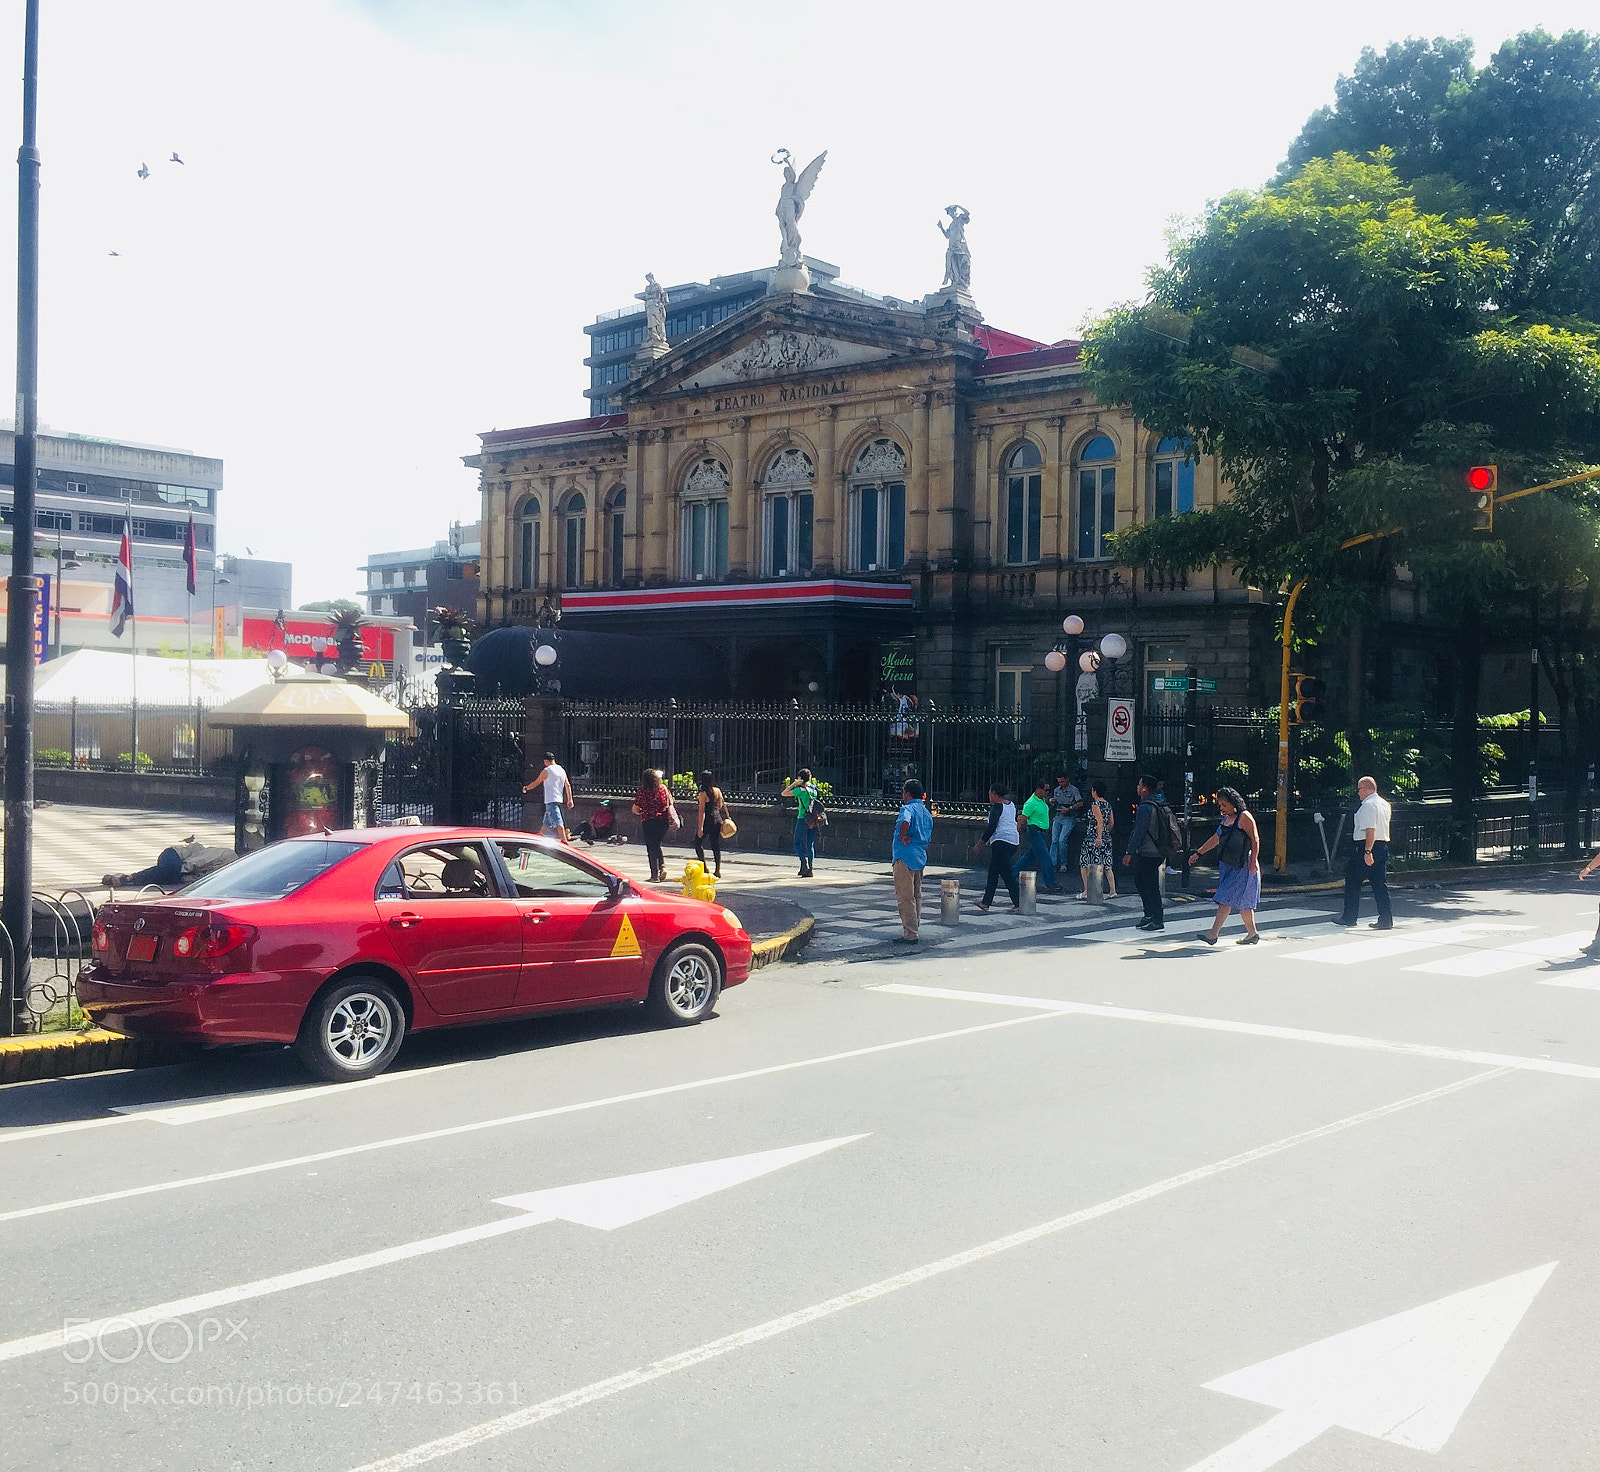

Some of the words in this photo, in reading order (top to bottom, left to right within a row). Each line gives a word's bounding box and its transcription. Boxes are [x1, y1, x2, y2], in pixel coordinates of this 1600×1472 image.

[714, 393, 765, 411] TEATRO
[779, 380, 849, 402] NACIONAL
[880, 651, 915, 667] Madre
[880, 665, 915, 681] Tierra
